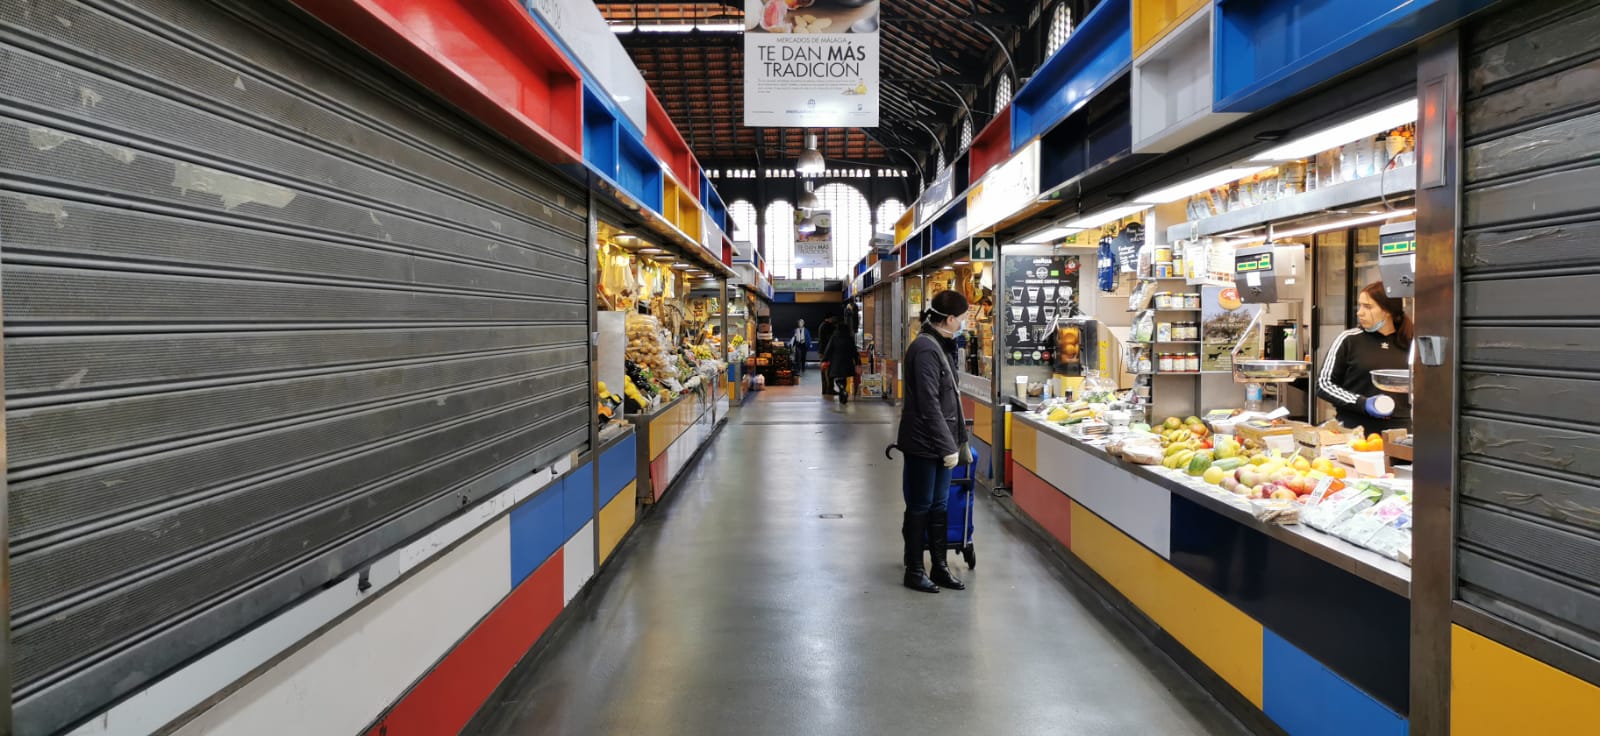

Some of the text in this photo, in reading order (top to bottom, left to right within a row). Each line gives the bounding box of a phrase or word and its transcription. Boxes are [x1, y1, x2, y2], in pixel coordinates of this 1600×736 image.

[758, 41, 866, 62] TE DAN MÁS
[764, 60, 860, 78] TRADICIÓN
